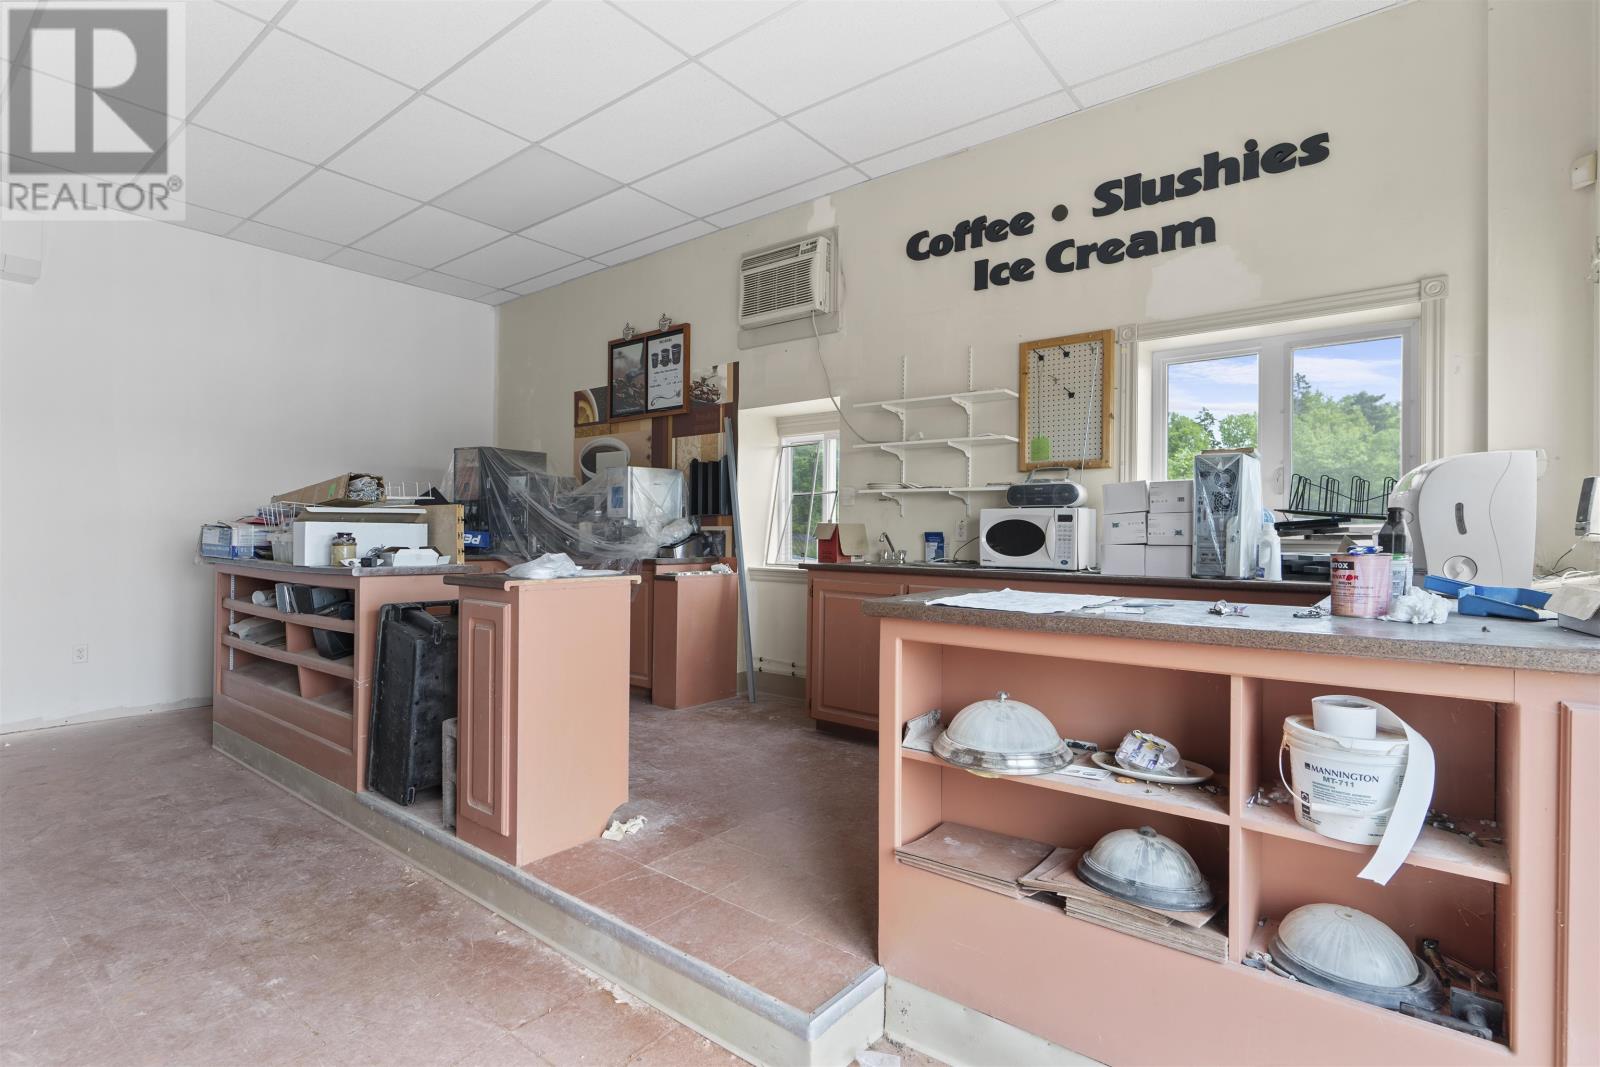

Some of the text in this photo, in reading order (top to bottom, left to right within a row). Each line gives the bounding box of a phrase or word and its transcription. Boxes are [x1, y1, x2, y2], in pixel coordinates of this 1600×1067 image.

[906, 132, 1330, 261] Coffee Slushies
[973, 216, 1217, 291] Ice Cream
[1311, 763, 1380, 783] MANNINGTON
[1322, 775, 1355, 788] MT-711
